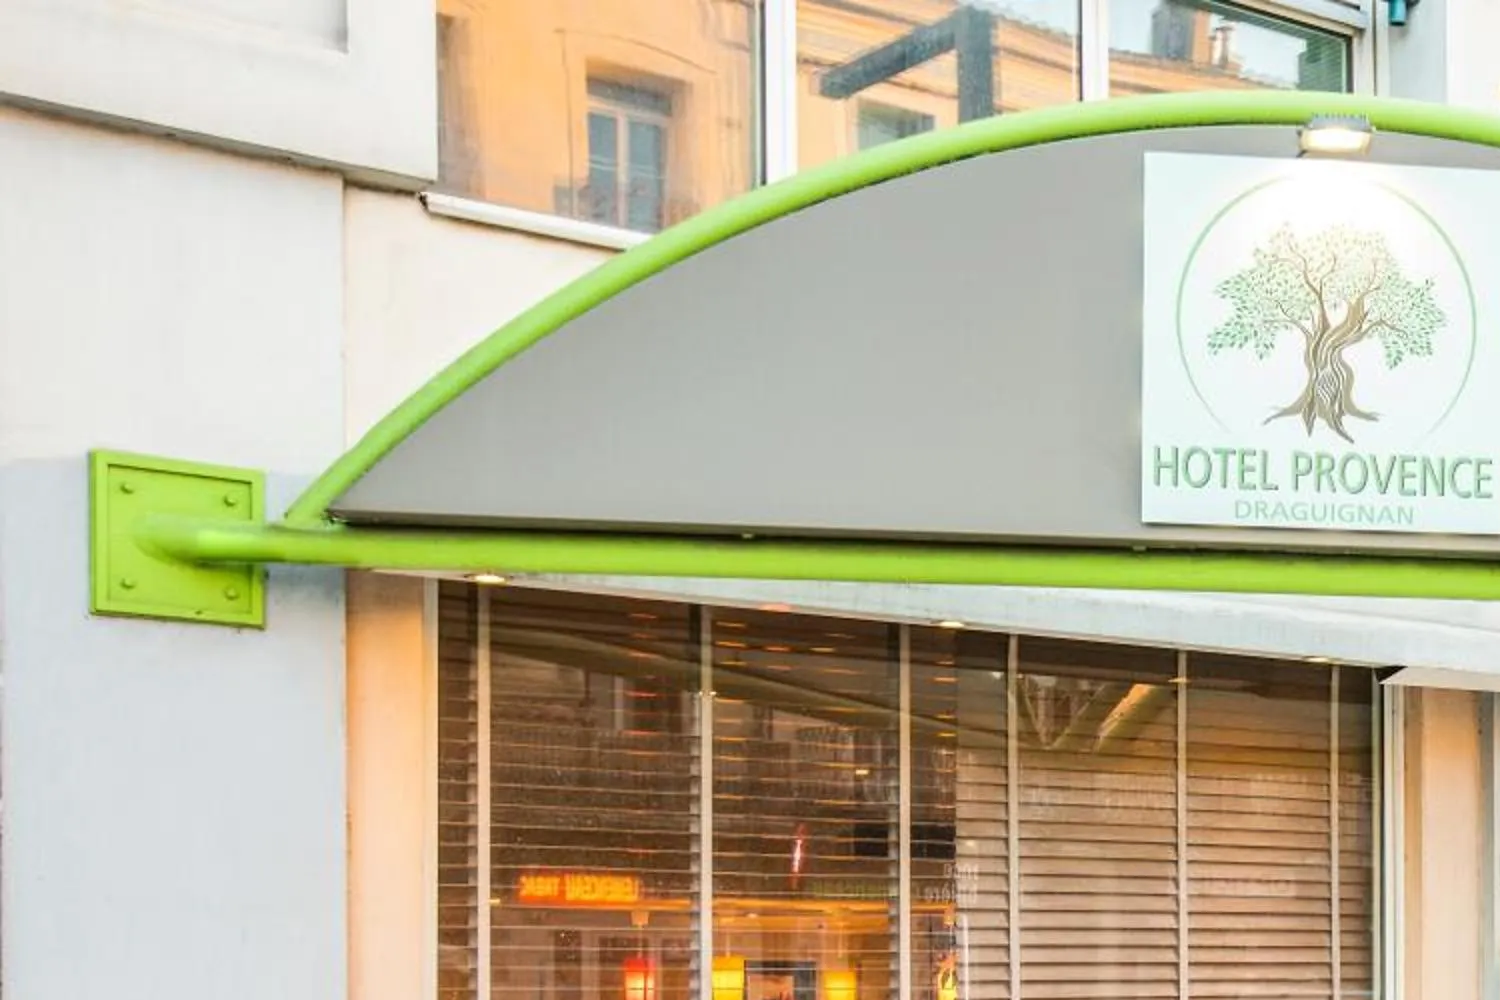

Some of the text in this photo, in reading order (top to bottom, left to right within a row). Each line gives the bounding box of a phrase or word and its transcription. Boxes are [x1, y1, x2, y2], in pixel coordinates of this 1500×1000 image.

[1152, 445, 1494, 499] HOTEL PROVENCE
[1234, 500, 1415, 525] DRAGUIGNAN
